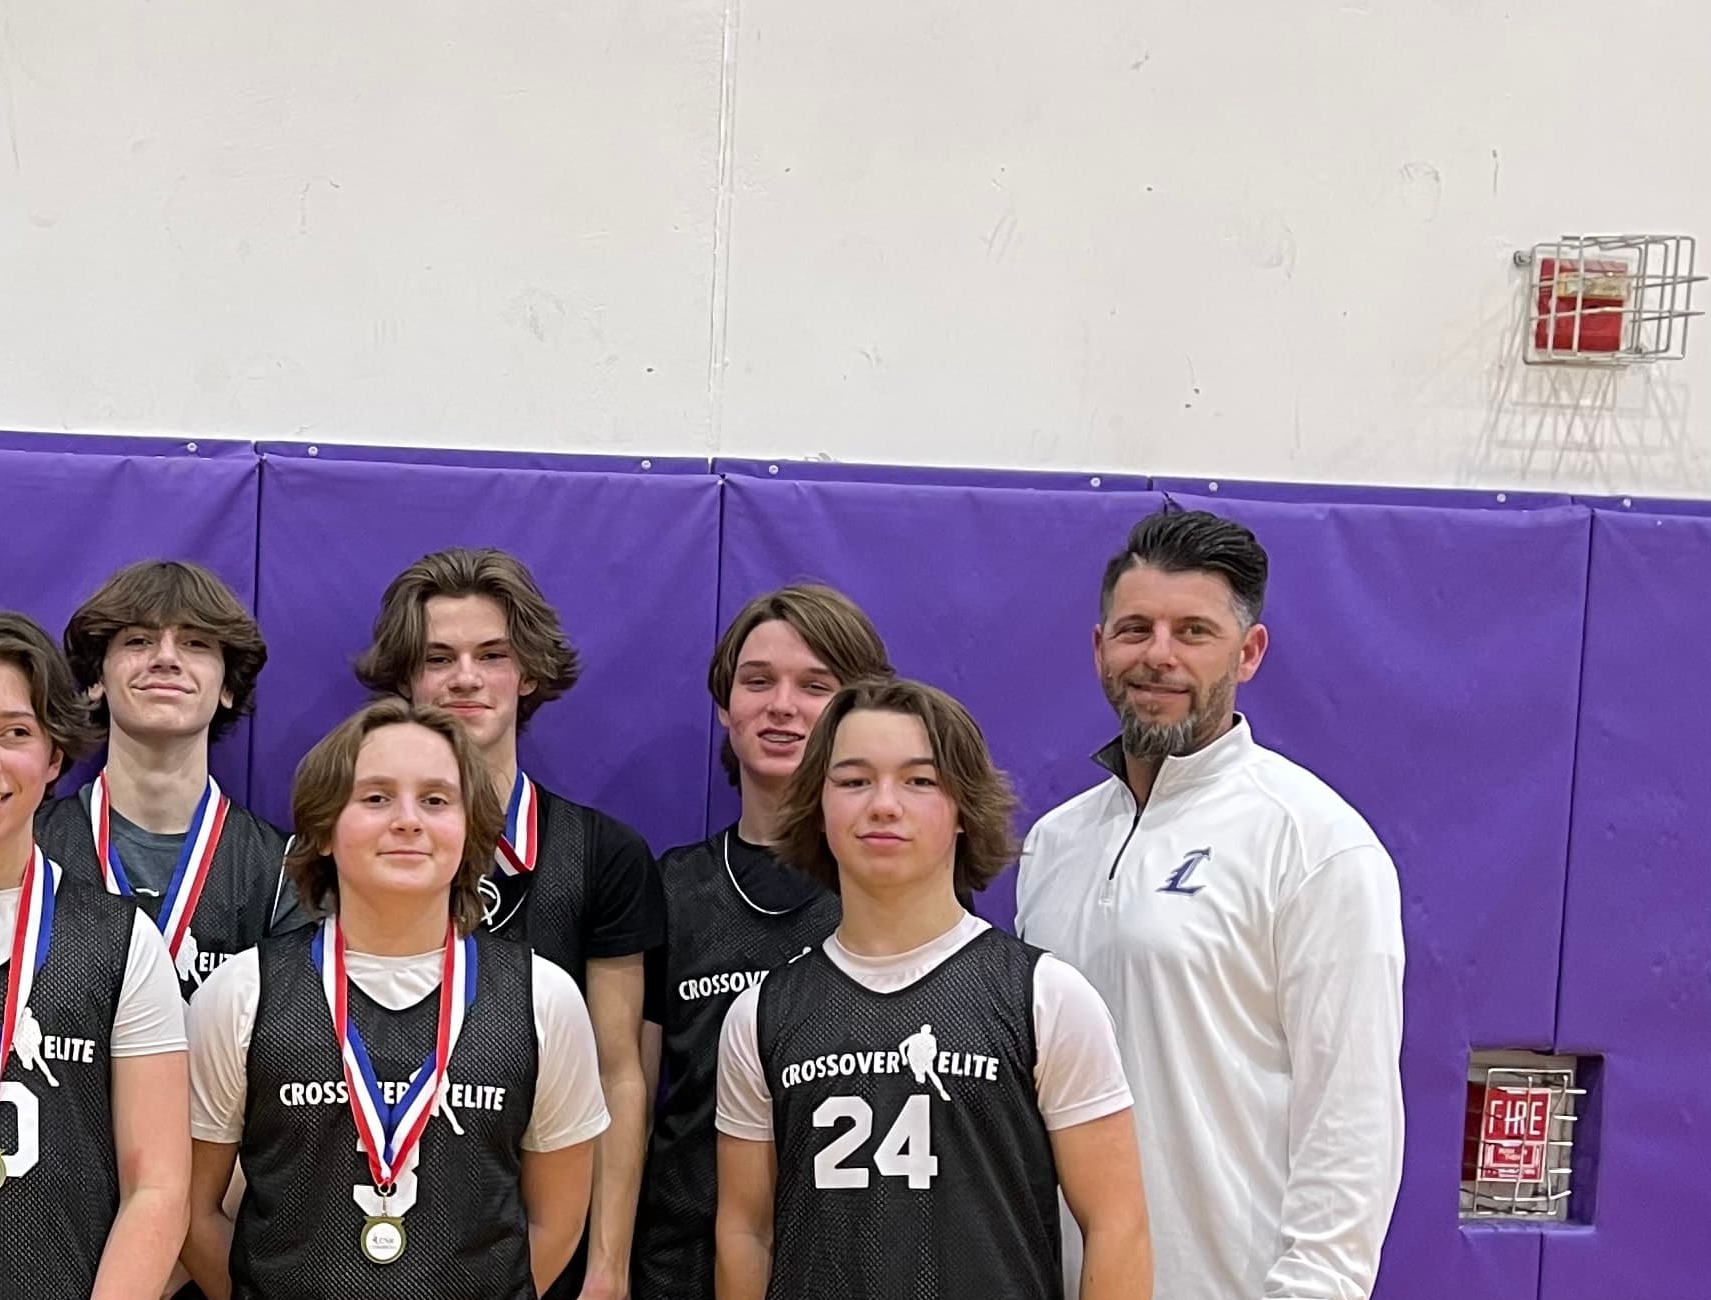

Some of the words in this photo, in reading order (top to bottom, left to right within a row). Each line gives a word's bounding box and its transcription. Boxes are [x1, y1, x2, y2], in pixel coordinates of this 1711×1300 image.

[44, 1035, 96, 1063] ELITE
[781, 1051, 900, 1088] CROSSOVER
[938, 1051, 999, 1081] ELITE
[452, 1083, 506, 1112] ELITE
[1488, 1100, 1543, 1136] FIRE
[812, 1094, 938, 1190] 24
